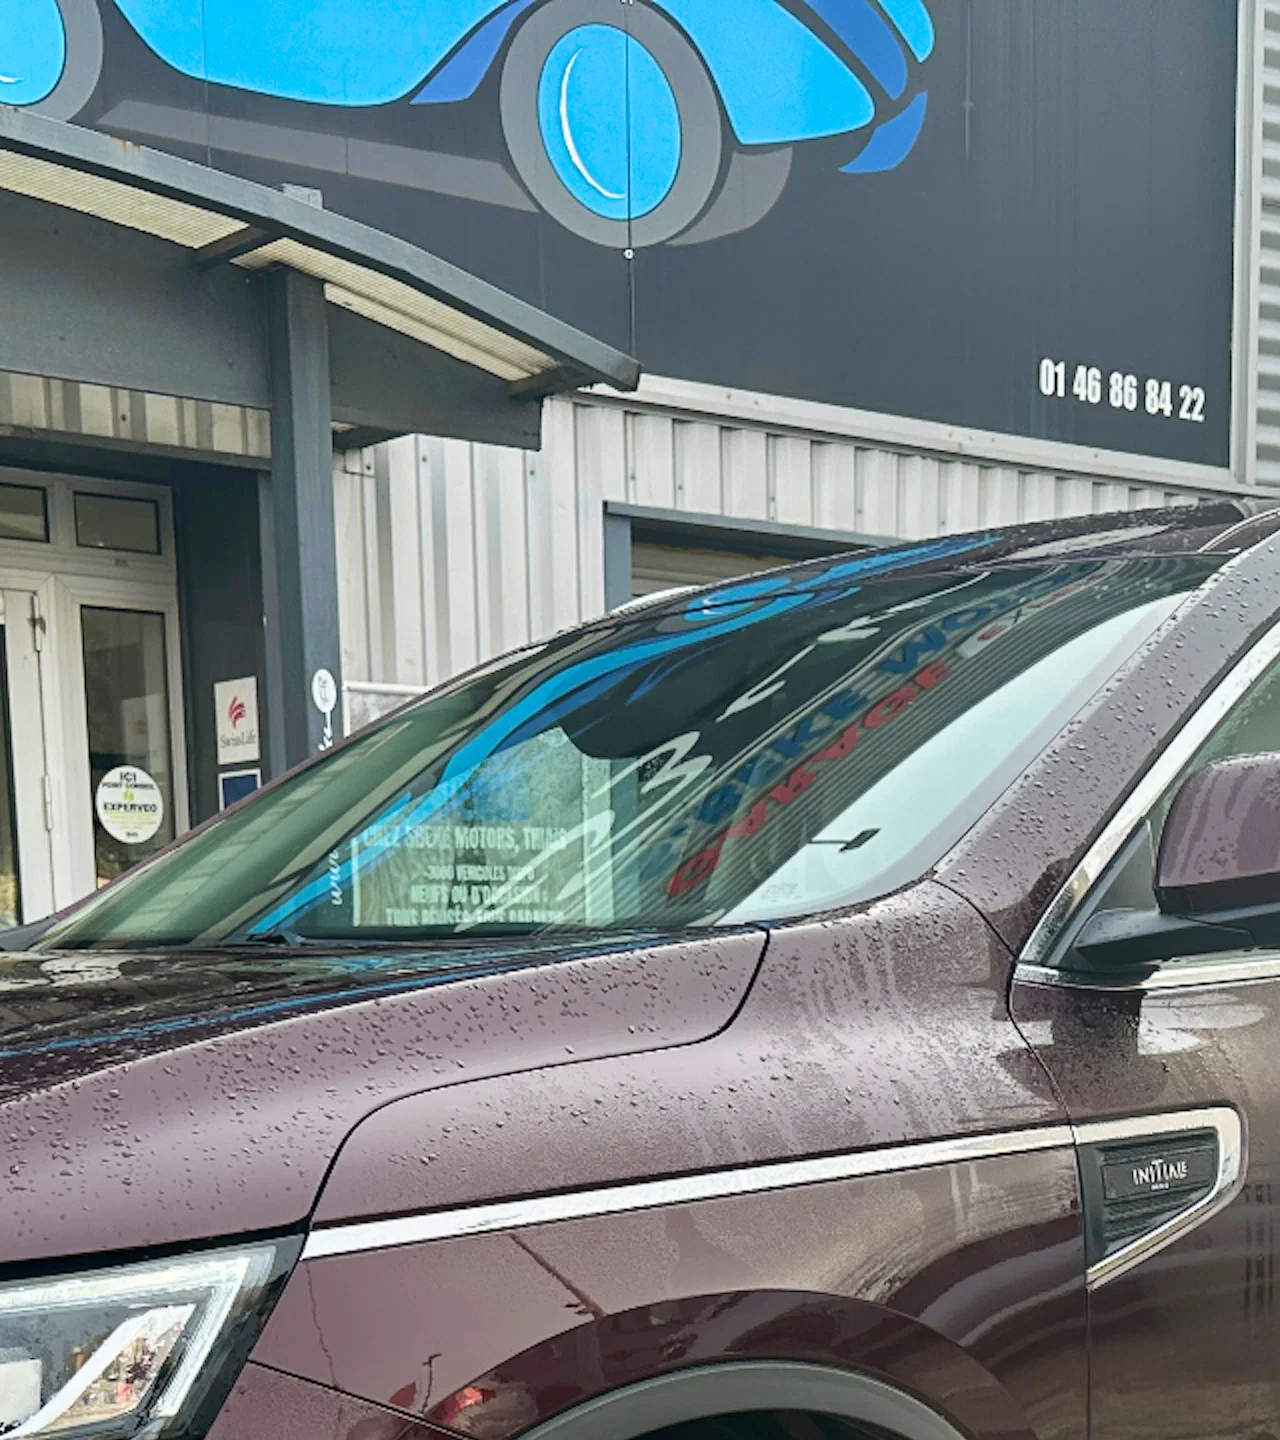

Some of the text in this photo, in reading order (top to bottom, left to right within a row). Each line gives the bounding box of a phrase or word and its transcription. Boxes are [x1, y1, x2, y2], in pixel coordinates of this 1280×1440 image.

[1038, 357, 1205, 423] 01 46 86 84 22
[120, 772, 137, 782] ICI
